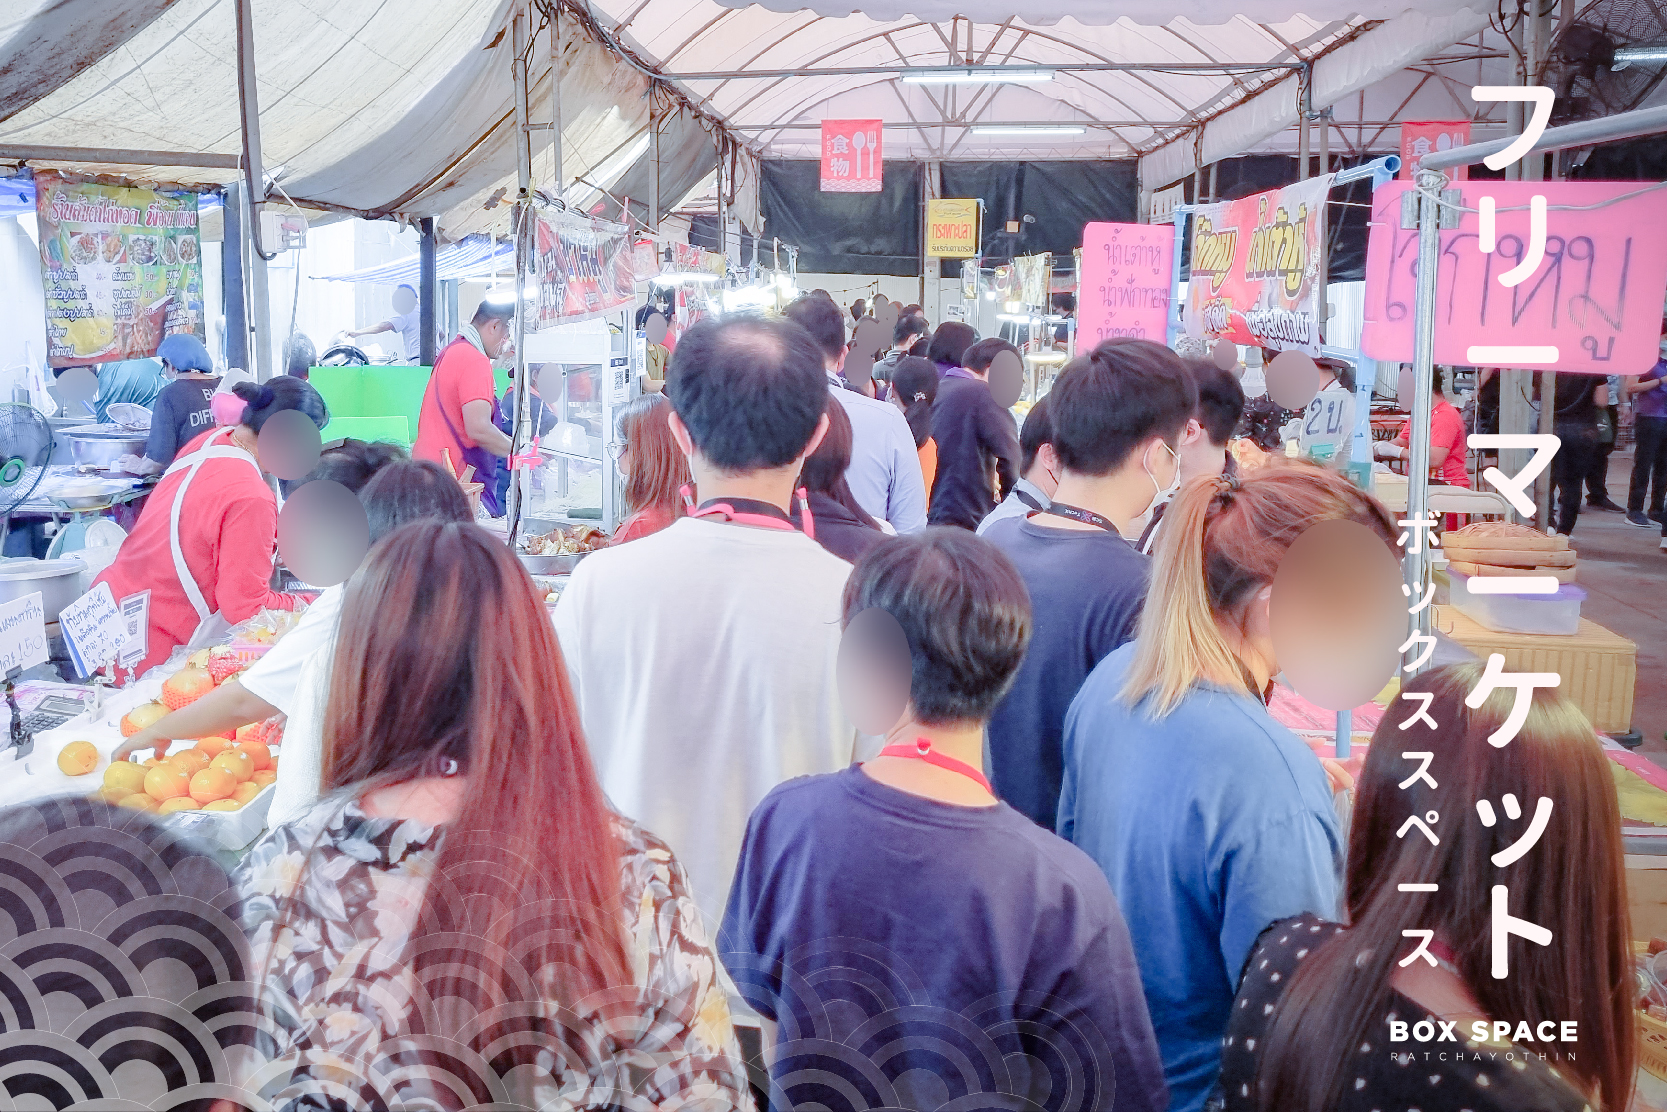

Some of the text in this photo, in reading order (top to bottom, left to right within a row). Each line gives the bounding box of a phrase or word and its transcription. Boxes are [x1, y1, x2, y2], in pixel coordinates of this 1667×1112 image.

[831, 134, 850, 177] 食物
[932, 220, 972, 239] กระเพาะปลา
[1103, 228, 1164, 275] น้ำเต้าหู้
[1099, 269, 1169, 309] น้ำฟักทอง
[1377, 194, 1632, 362] โจกหมู
[17, 634, 43, 662] 150
